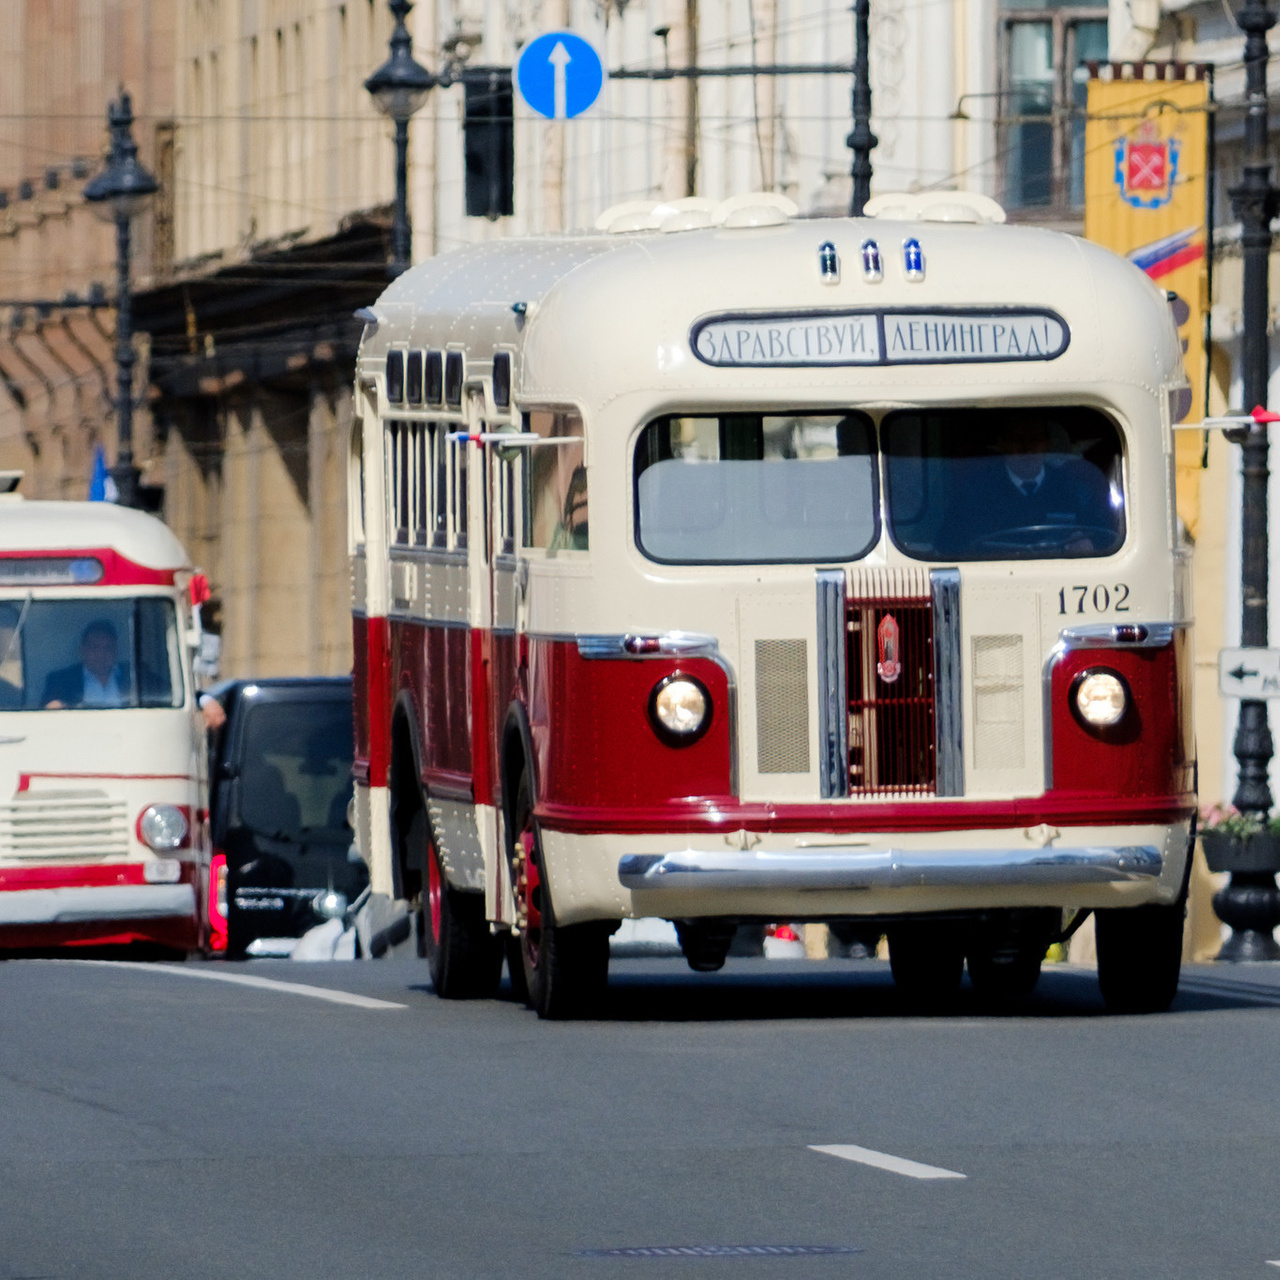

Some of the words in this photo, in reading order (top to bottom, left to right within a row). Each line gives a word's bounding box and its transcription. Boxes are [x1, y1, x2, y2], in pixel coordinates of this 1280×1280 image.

[703, 317, 875, 363] ЗДРАВСТВУЙ,
[892, 318, 1051, 357] ЛЕНИНГРАД!
[1058, 583, 1130, 615] 1702
